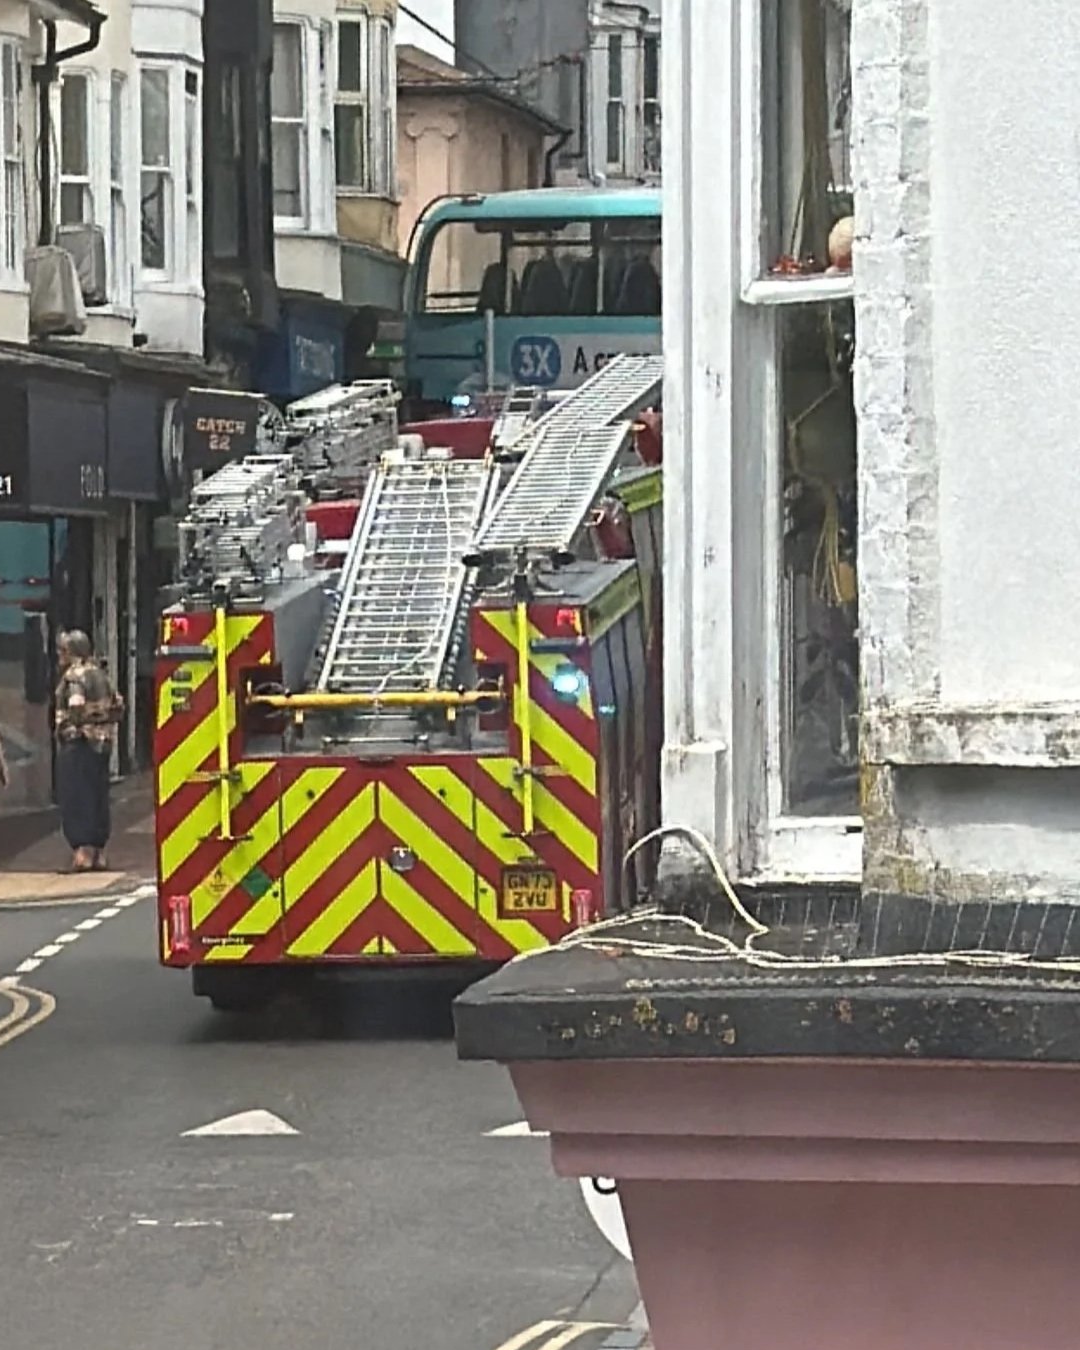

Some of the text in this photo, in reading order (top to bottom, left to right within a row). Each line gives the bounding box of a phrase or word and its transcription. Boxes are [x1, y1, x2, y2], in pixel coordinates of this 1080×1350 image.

[519, 344, 553, 377] 3X
[573, 347, 588, 374] A
[196, 417, 245, 434] CATCH
[209, 435, 230, 450] 22
